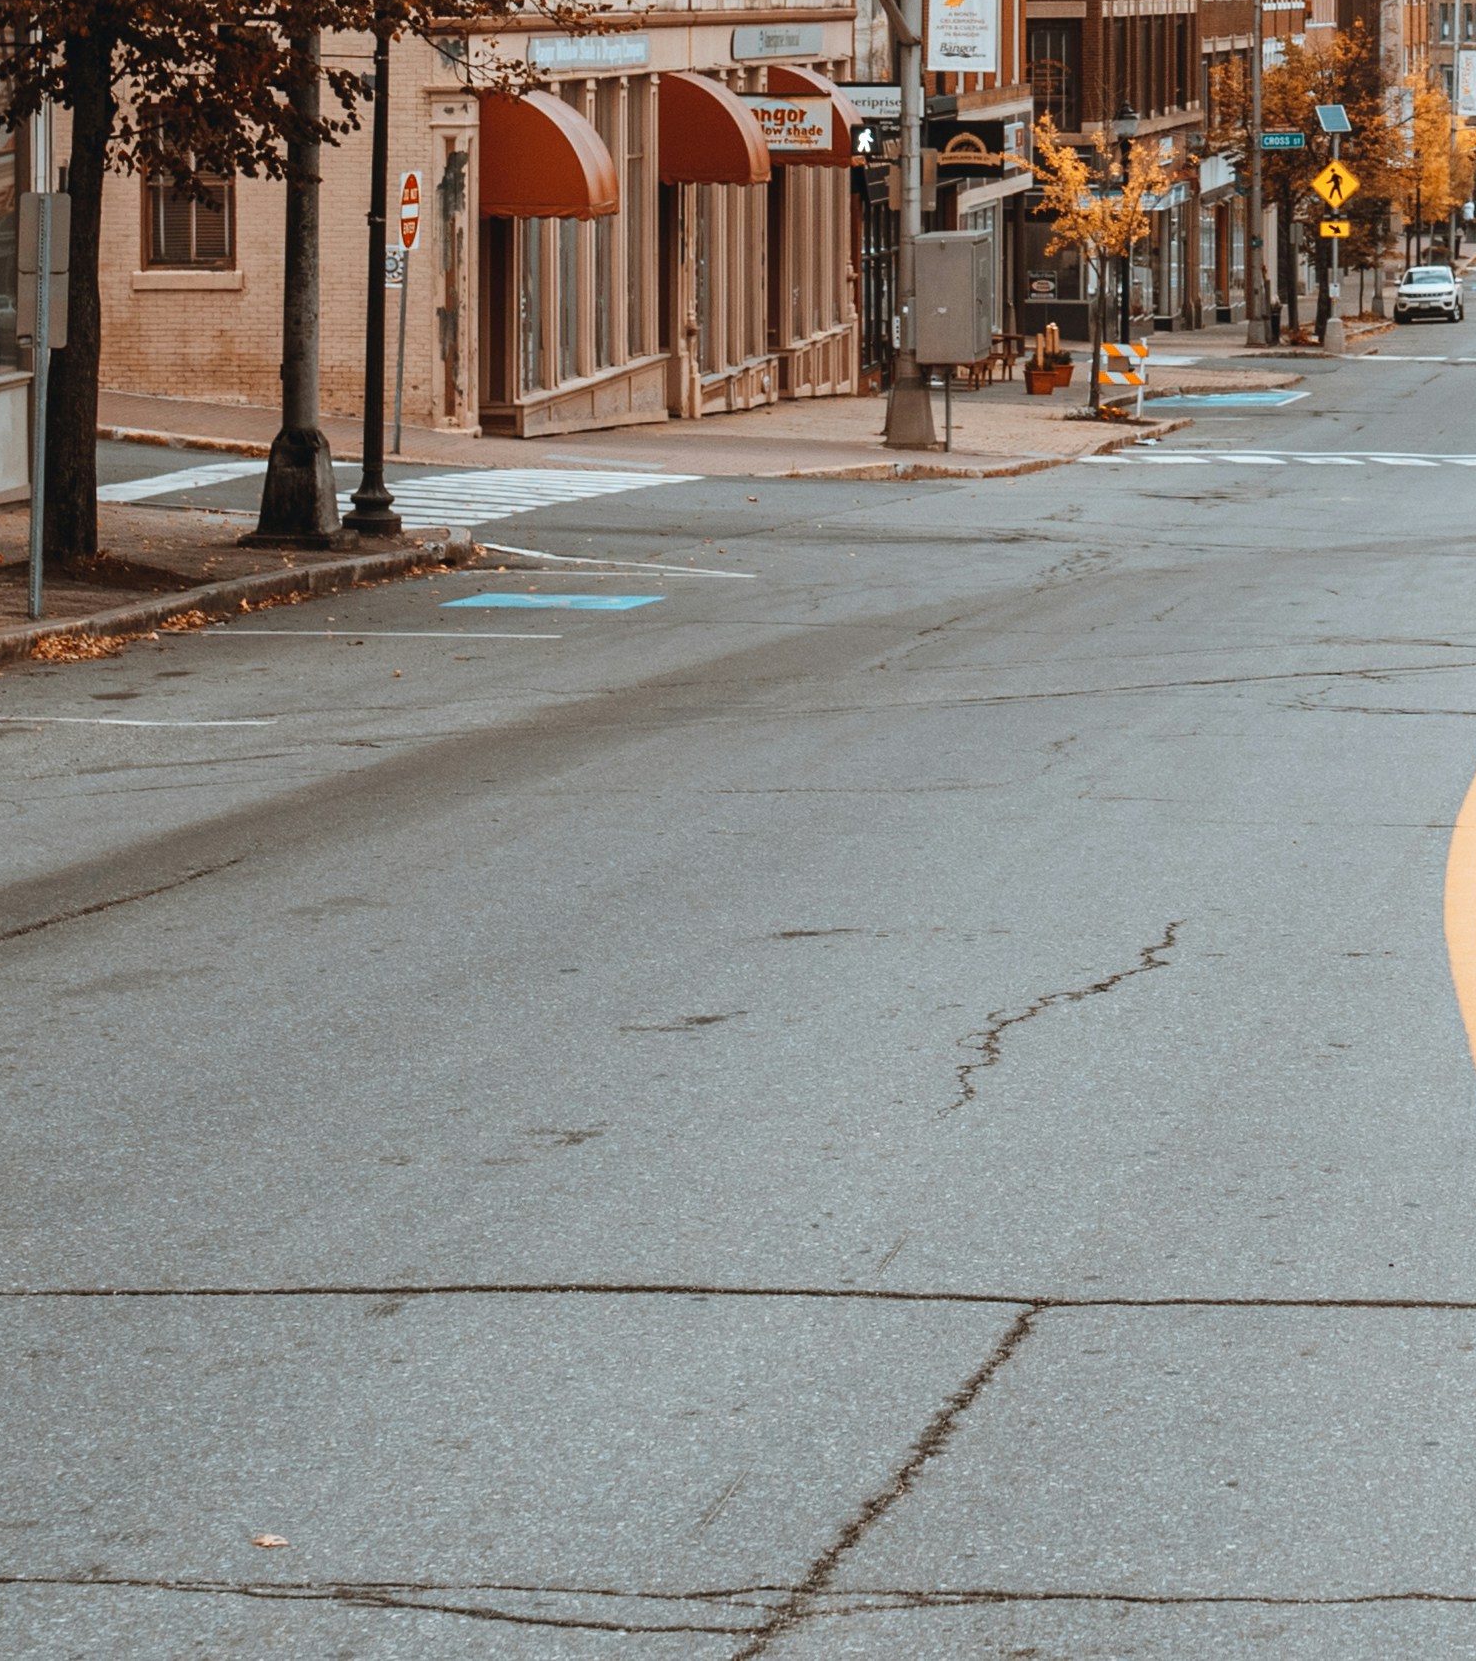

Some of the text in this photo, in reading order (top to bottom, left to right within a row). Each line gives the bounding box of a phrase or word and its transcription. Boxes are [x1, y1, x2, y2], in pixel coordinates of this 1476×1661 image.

[940, 42, 977, 54] Bangor
[750, 107, 808, 126] angor
[787, 124, 823, 136] shade
[1264, 136, 1290, 146] CROSS
